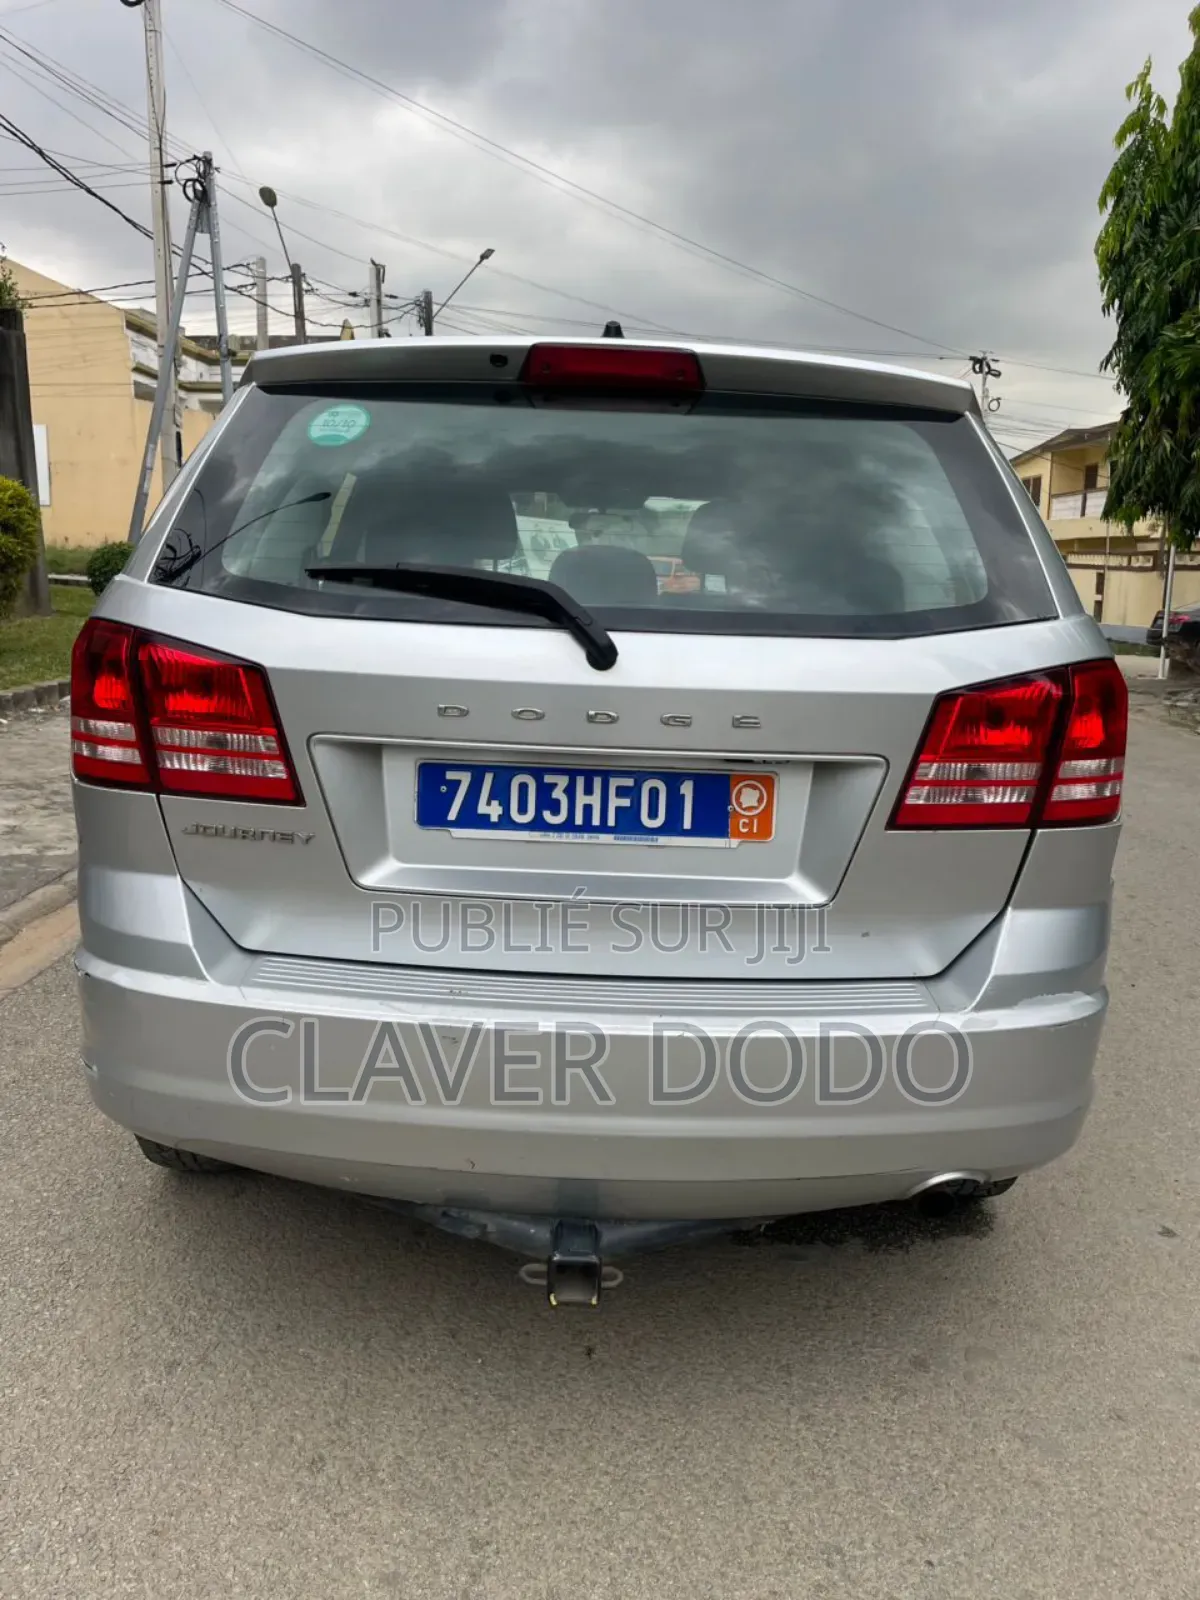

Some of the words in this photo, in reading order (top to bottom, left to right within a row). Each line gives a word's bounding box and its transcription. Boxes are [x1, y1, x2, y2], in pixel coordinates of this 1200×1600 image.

[437, 703, 761, 729] DODGE
[445, 770, 696, 830] 7403HF01
[739, 818, 758, 834] CI
[182, 822, 316, 845] JOURNEY
